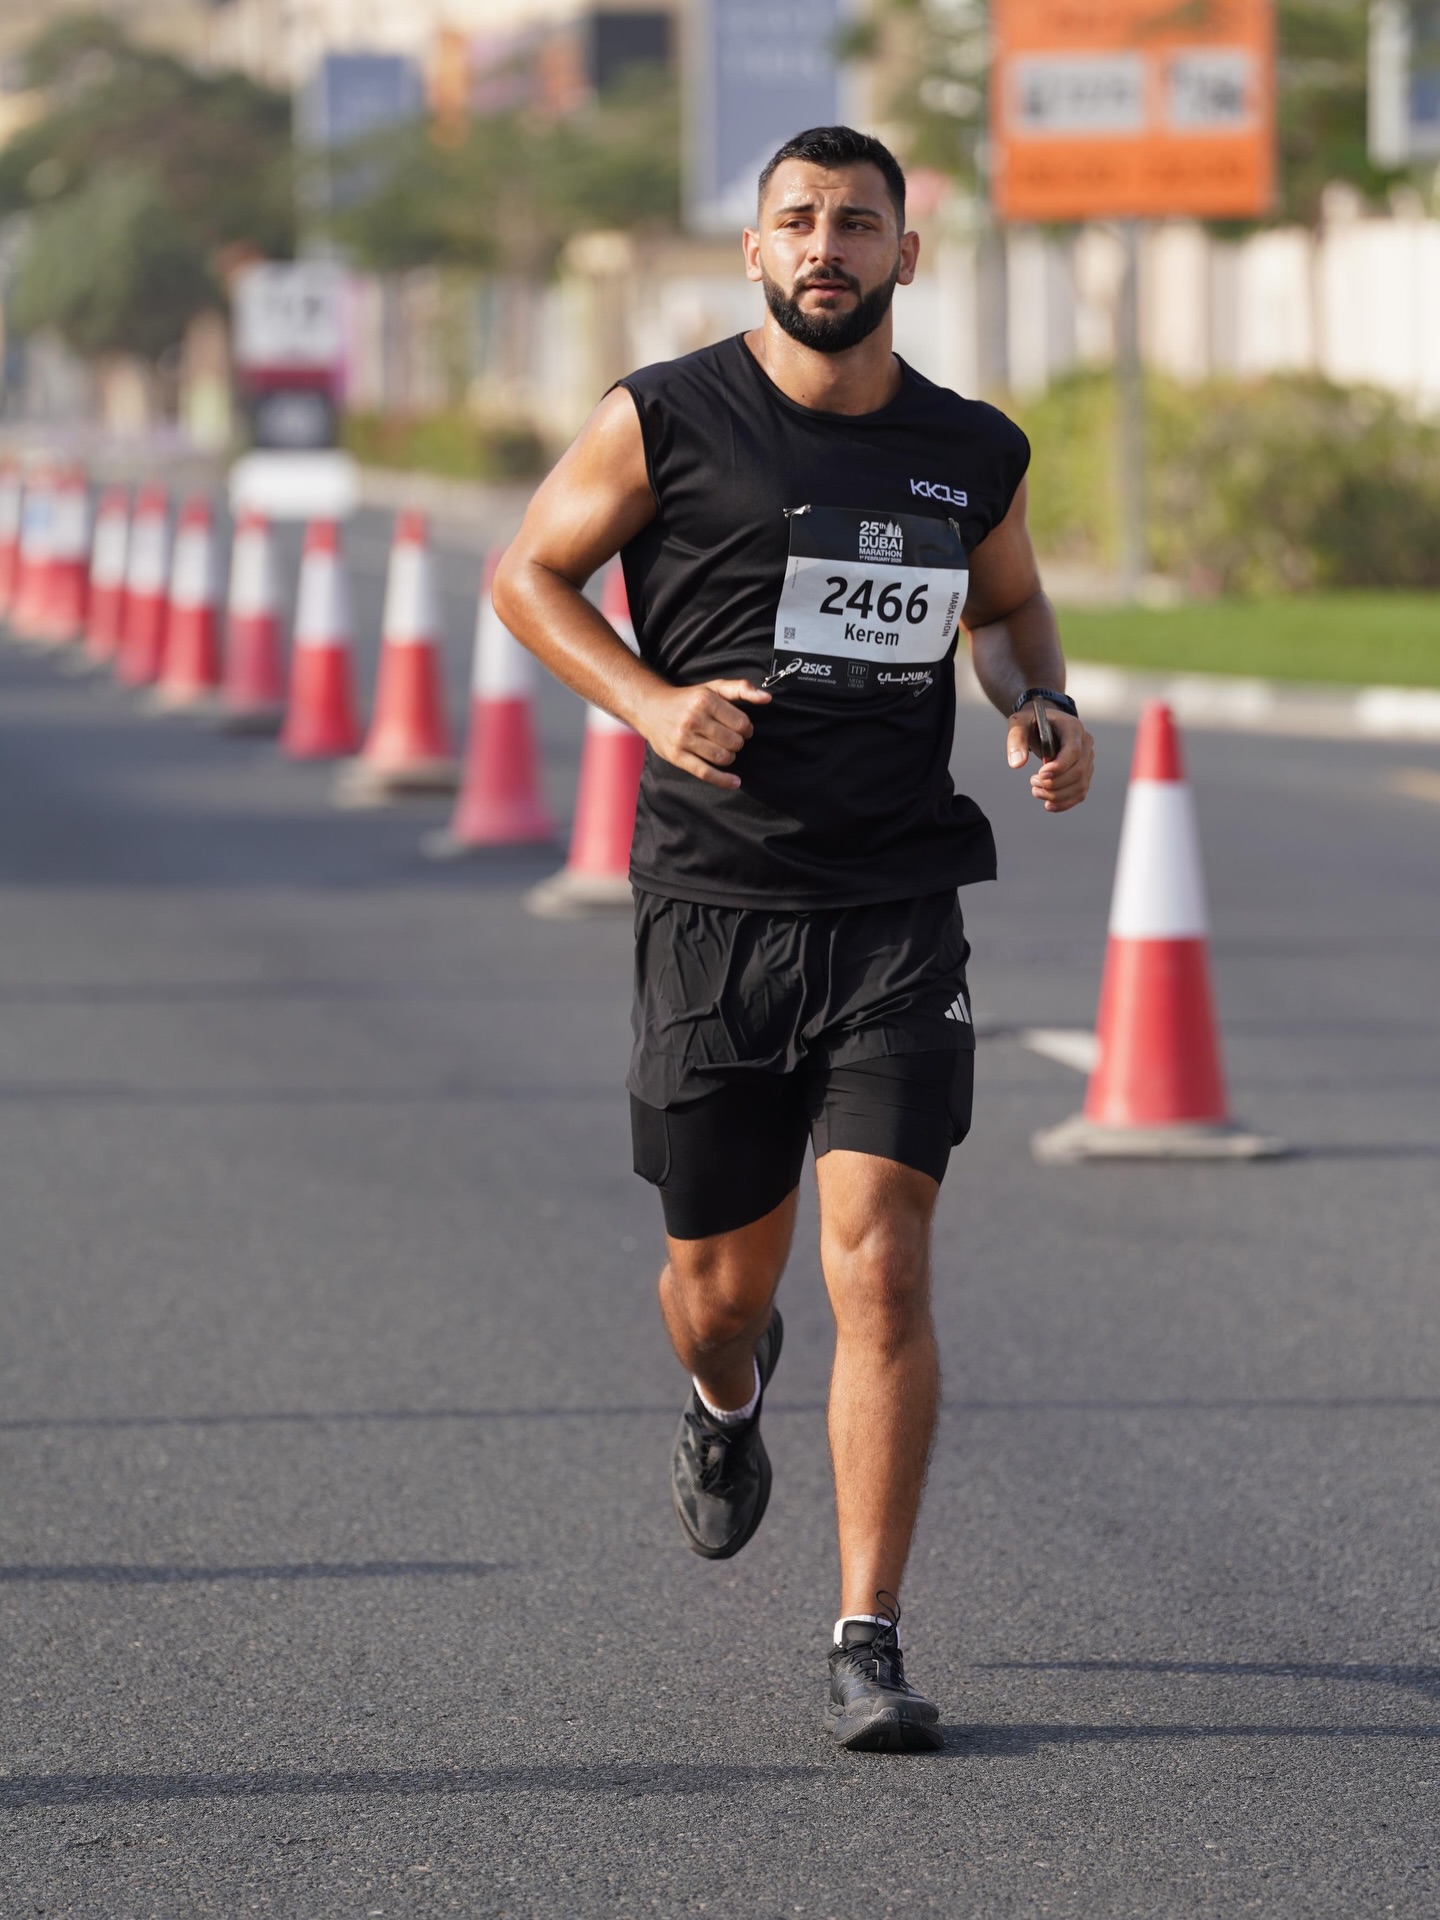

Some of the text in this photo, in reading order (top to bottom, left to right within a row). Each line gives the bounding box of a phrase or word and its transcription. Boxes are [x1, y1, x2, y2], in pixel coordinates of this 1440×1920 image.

[910, 478, 968, 507] KK13
[859, 520, 886, 536] 25th
[858, 547, 903, 558] MARATHON
[859, 535, 903, 551] DUBAI
[819, 576, 929, 624] 2466
[941, 591, 960, 637] MARATHON
[844, 623, 899, 646] Kerem
[851, 664, 866, 676] ITP
